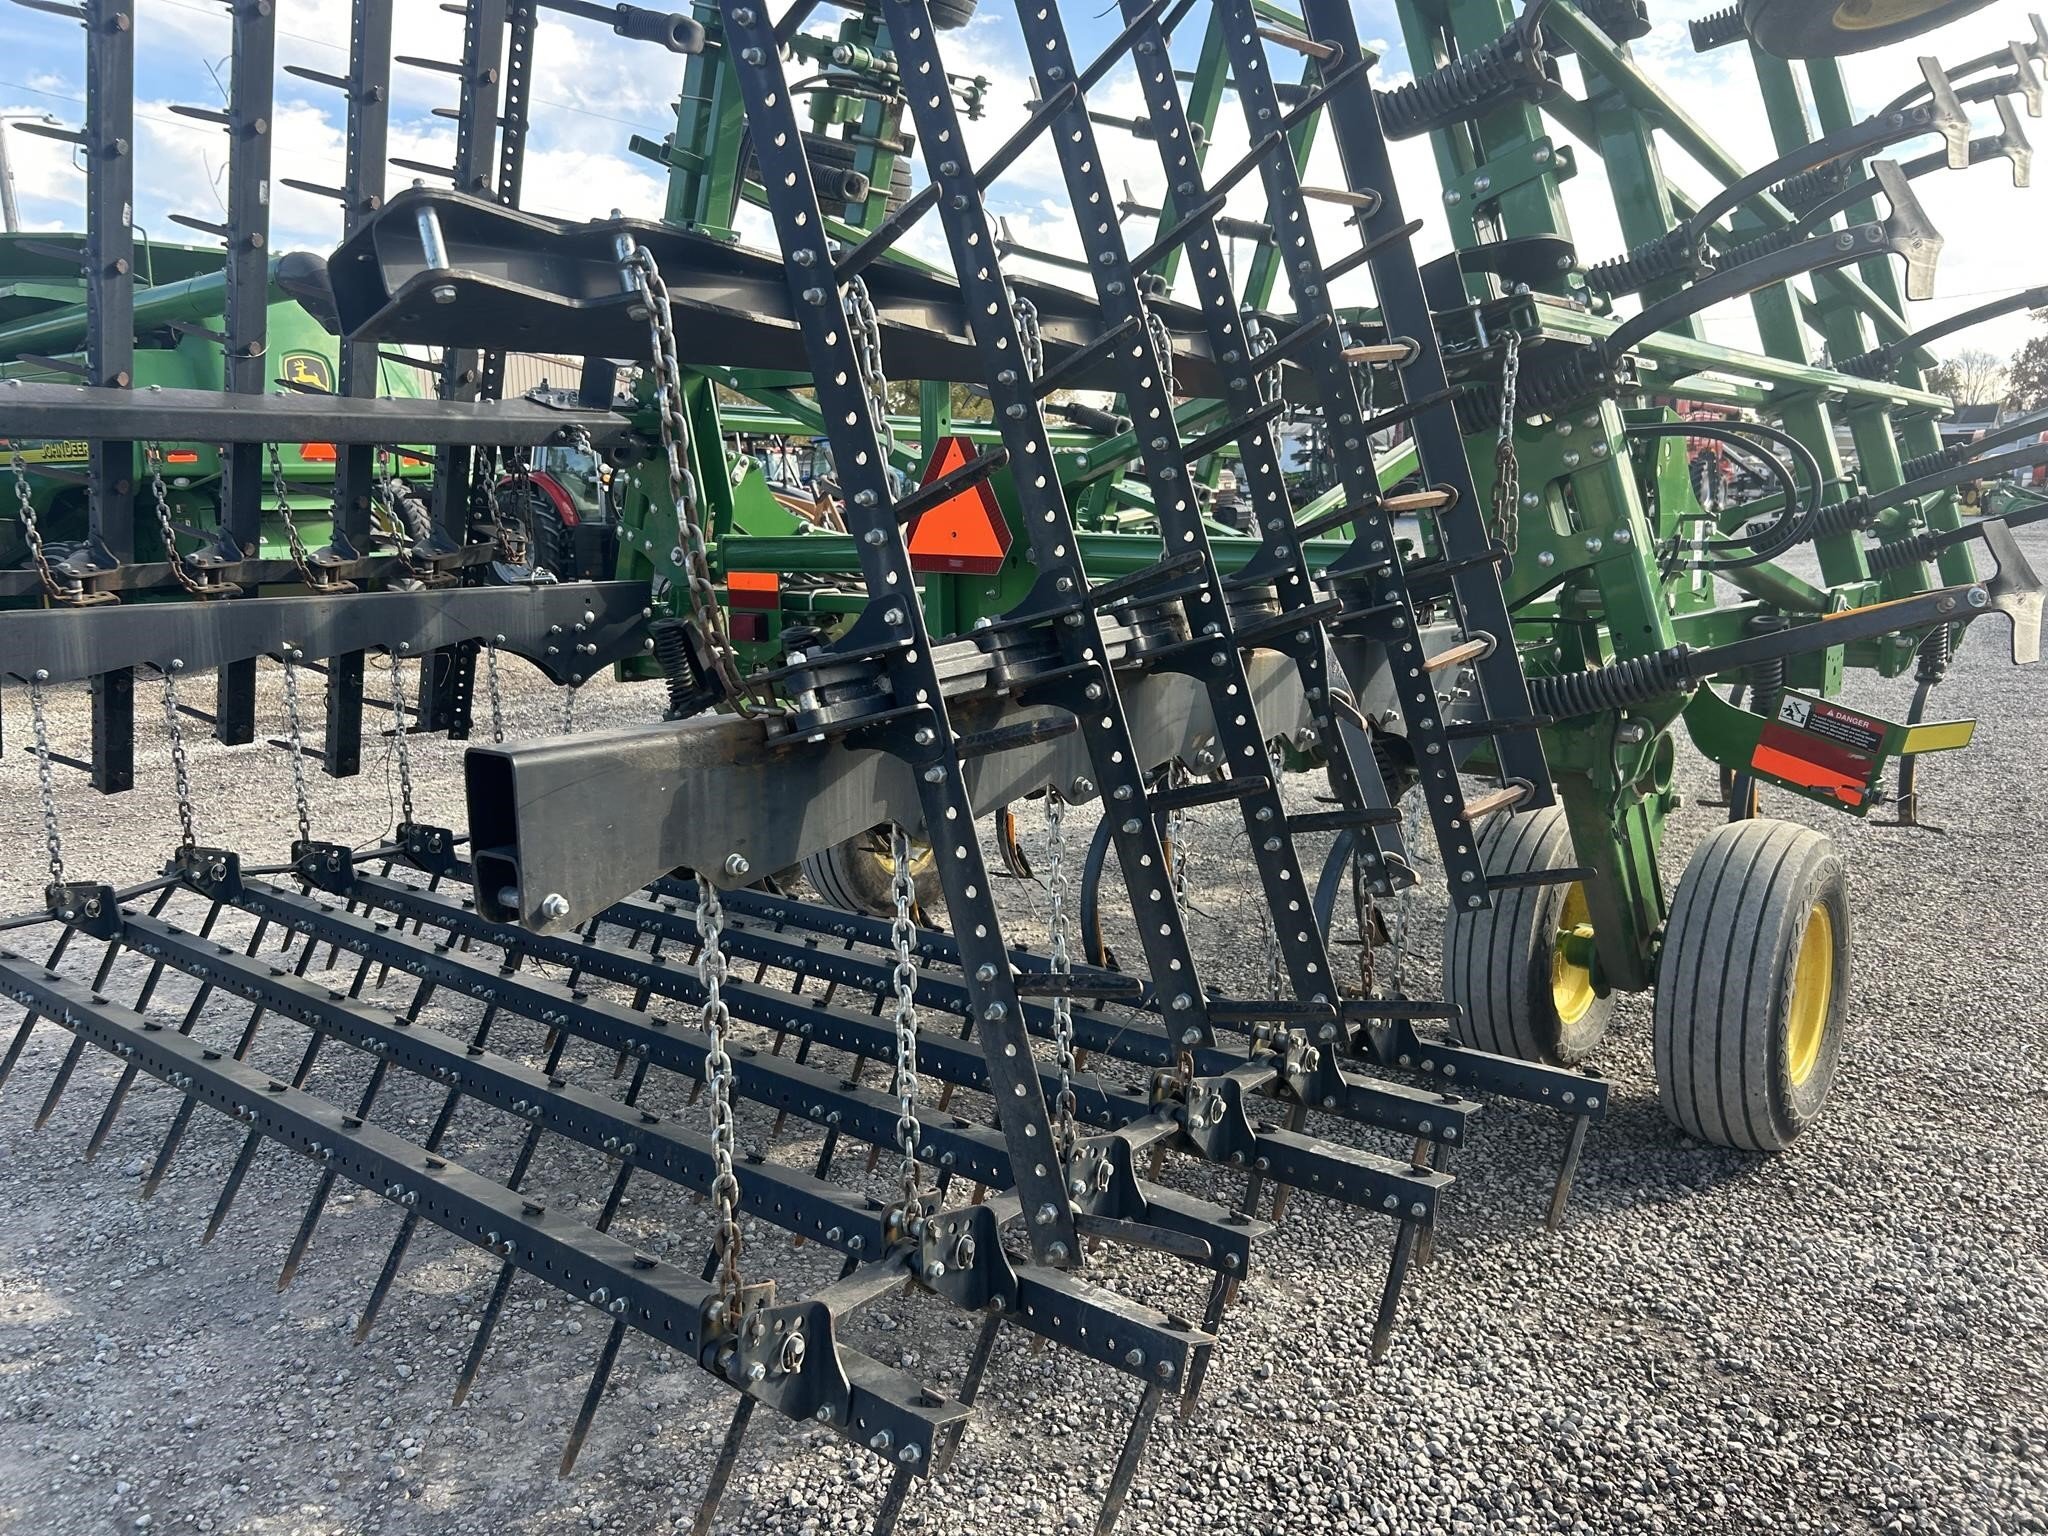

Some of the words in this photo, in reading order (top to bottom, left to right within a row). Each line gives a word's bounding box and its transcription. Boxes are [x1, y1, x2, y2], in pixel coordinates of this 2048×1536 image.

[42, 442, 64, 457] JOHN
[63, 440, 89, 456] DEER
[1836, 712, 1870, 728] DANGER
